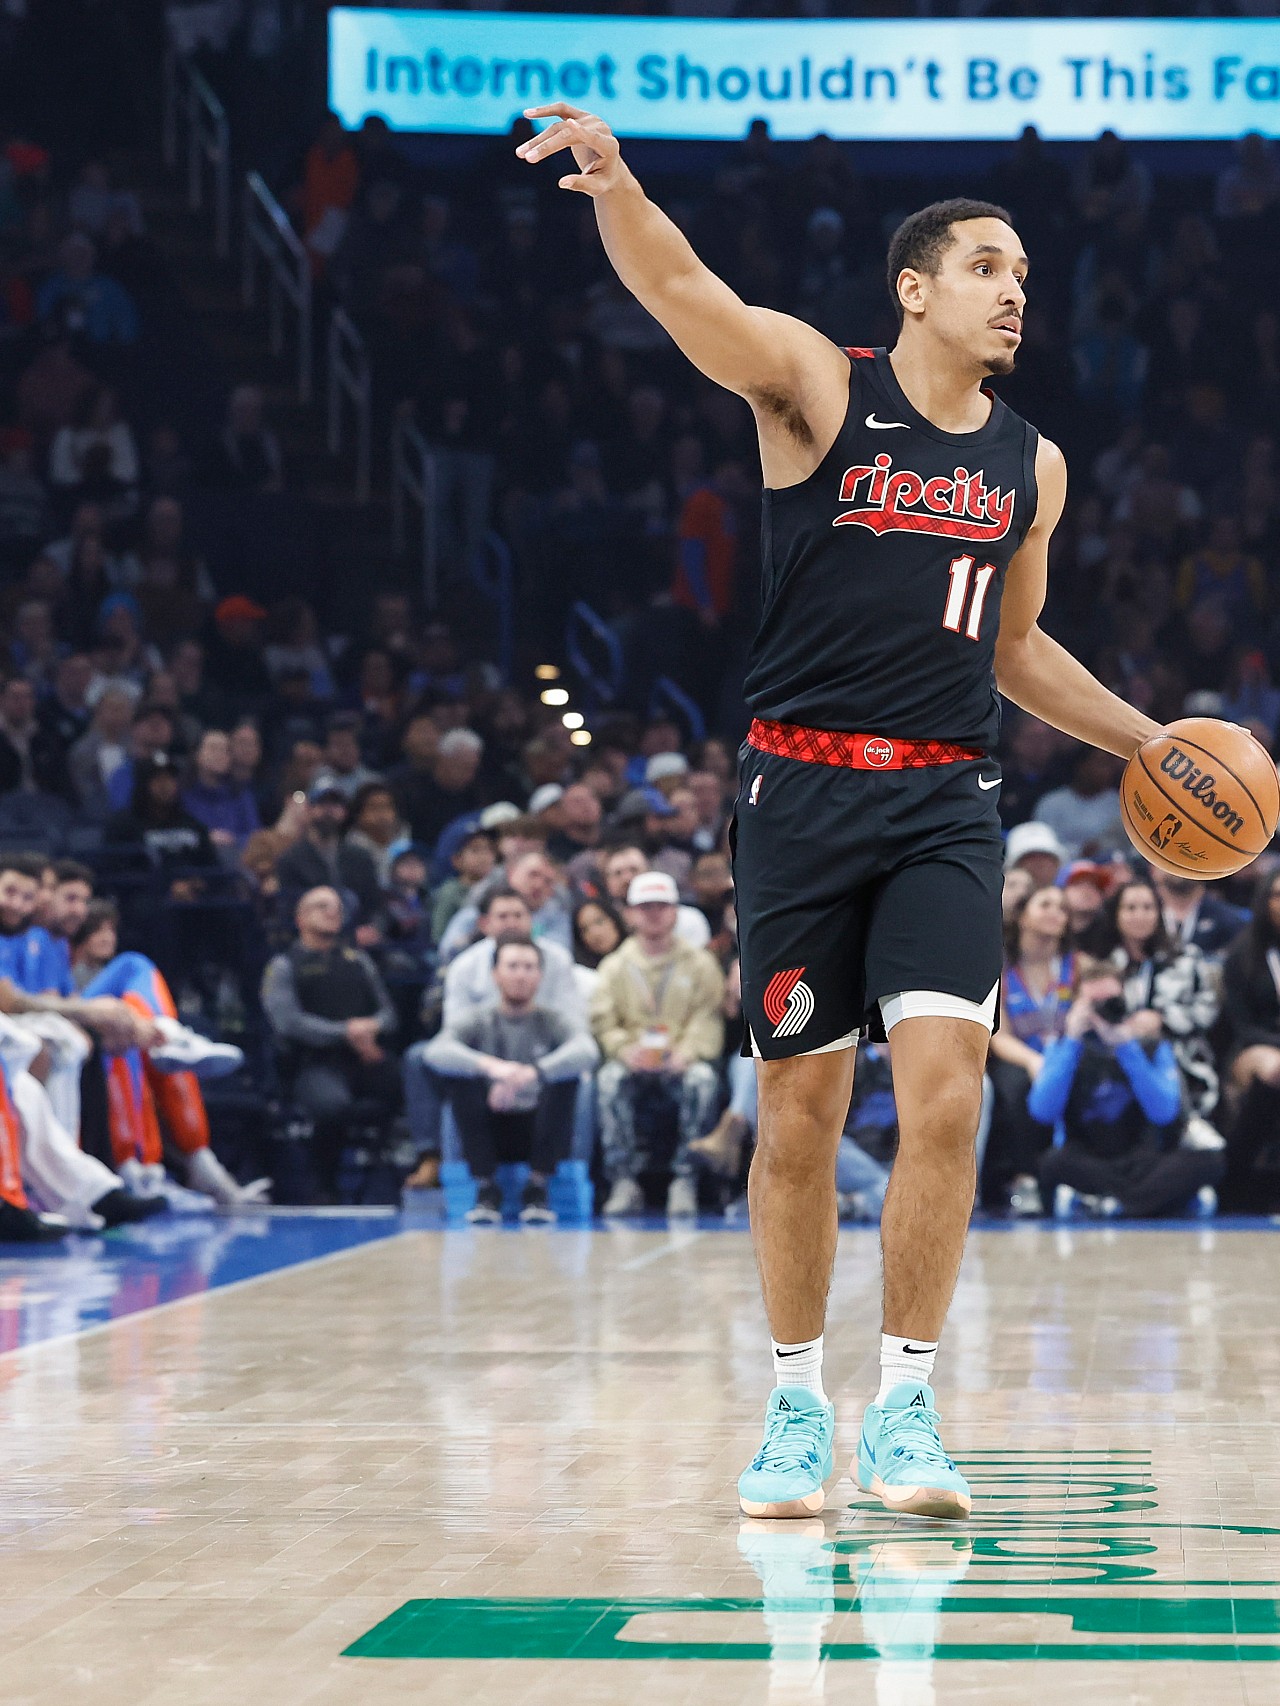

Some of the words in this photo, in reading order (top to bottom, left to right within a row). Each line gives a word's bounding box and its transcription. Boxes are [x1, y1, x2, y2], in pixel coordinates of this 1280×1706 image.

[365, 47, 614, 98] Internet
[966, 58, 1039, 101] Be
[1064, 53, 1188, 101] This
[833, 453, 1016, 542] ripcity
[942, 553, 996, 642] 11
[1159, 746, 1246, 838] Wilson
